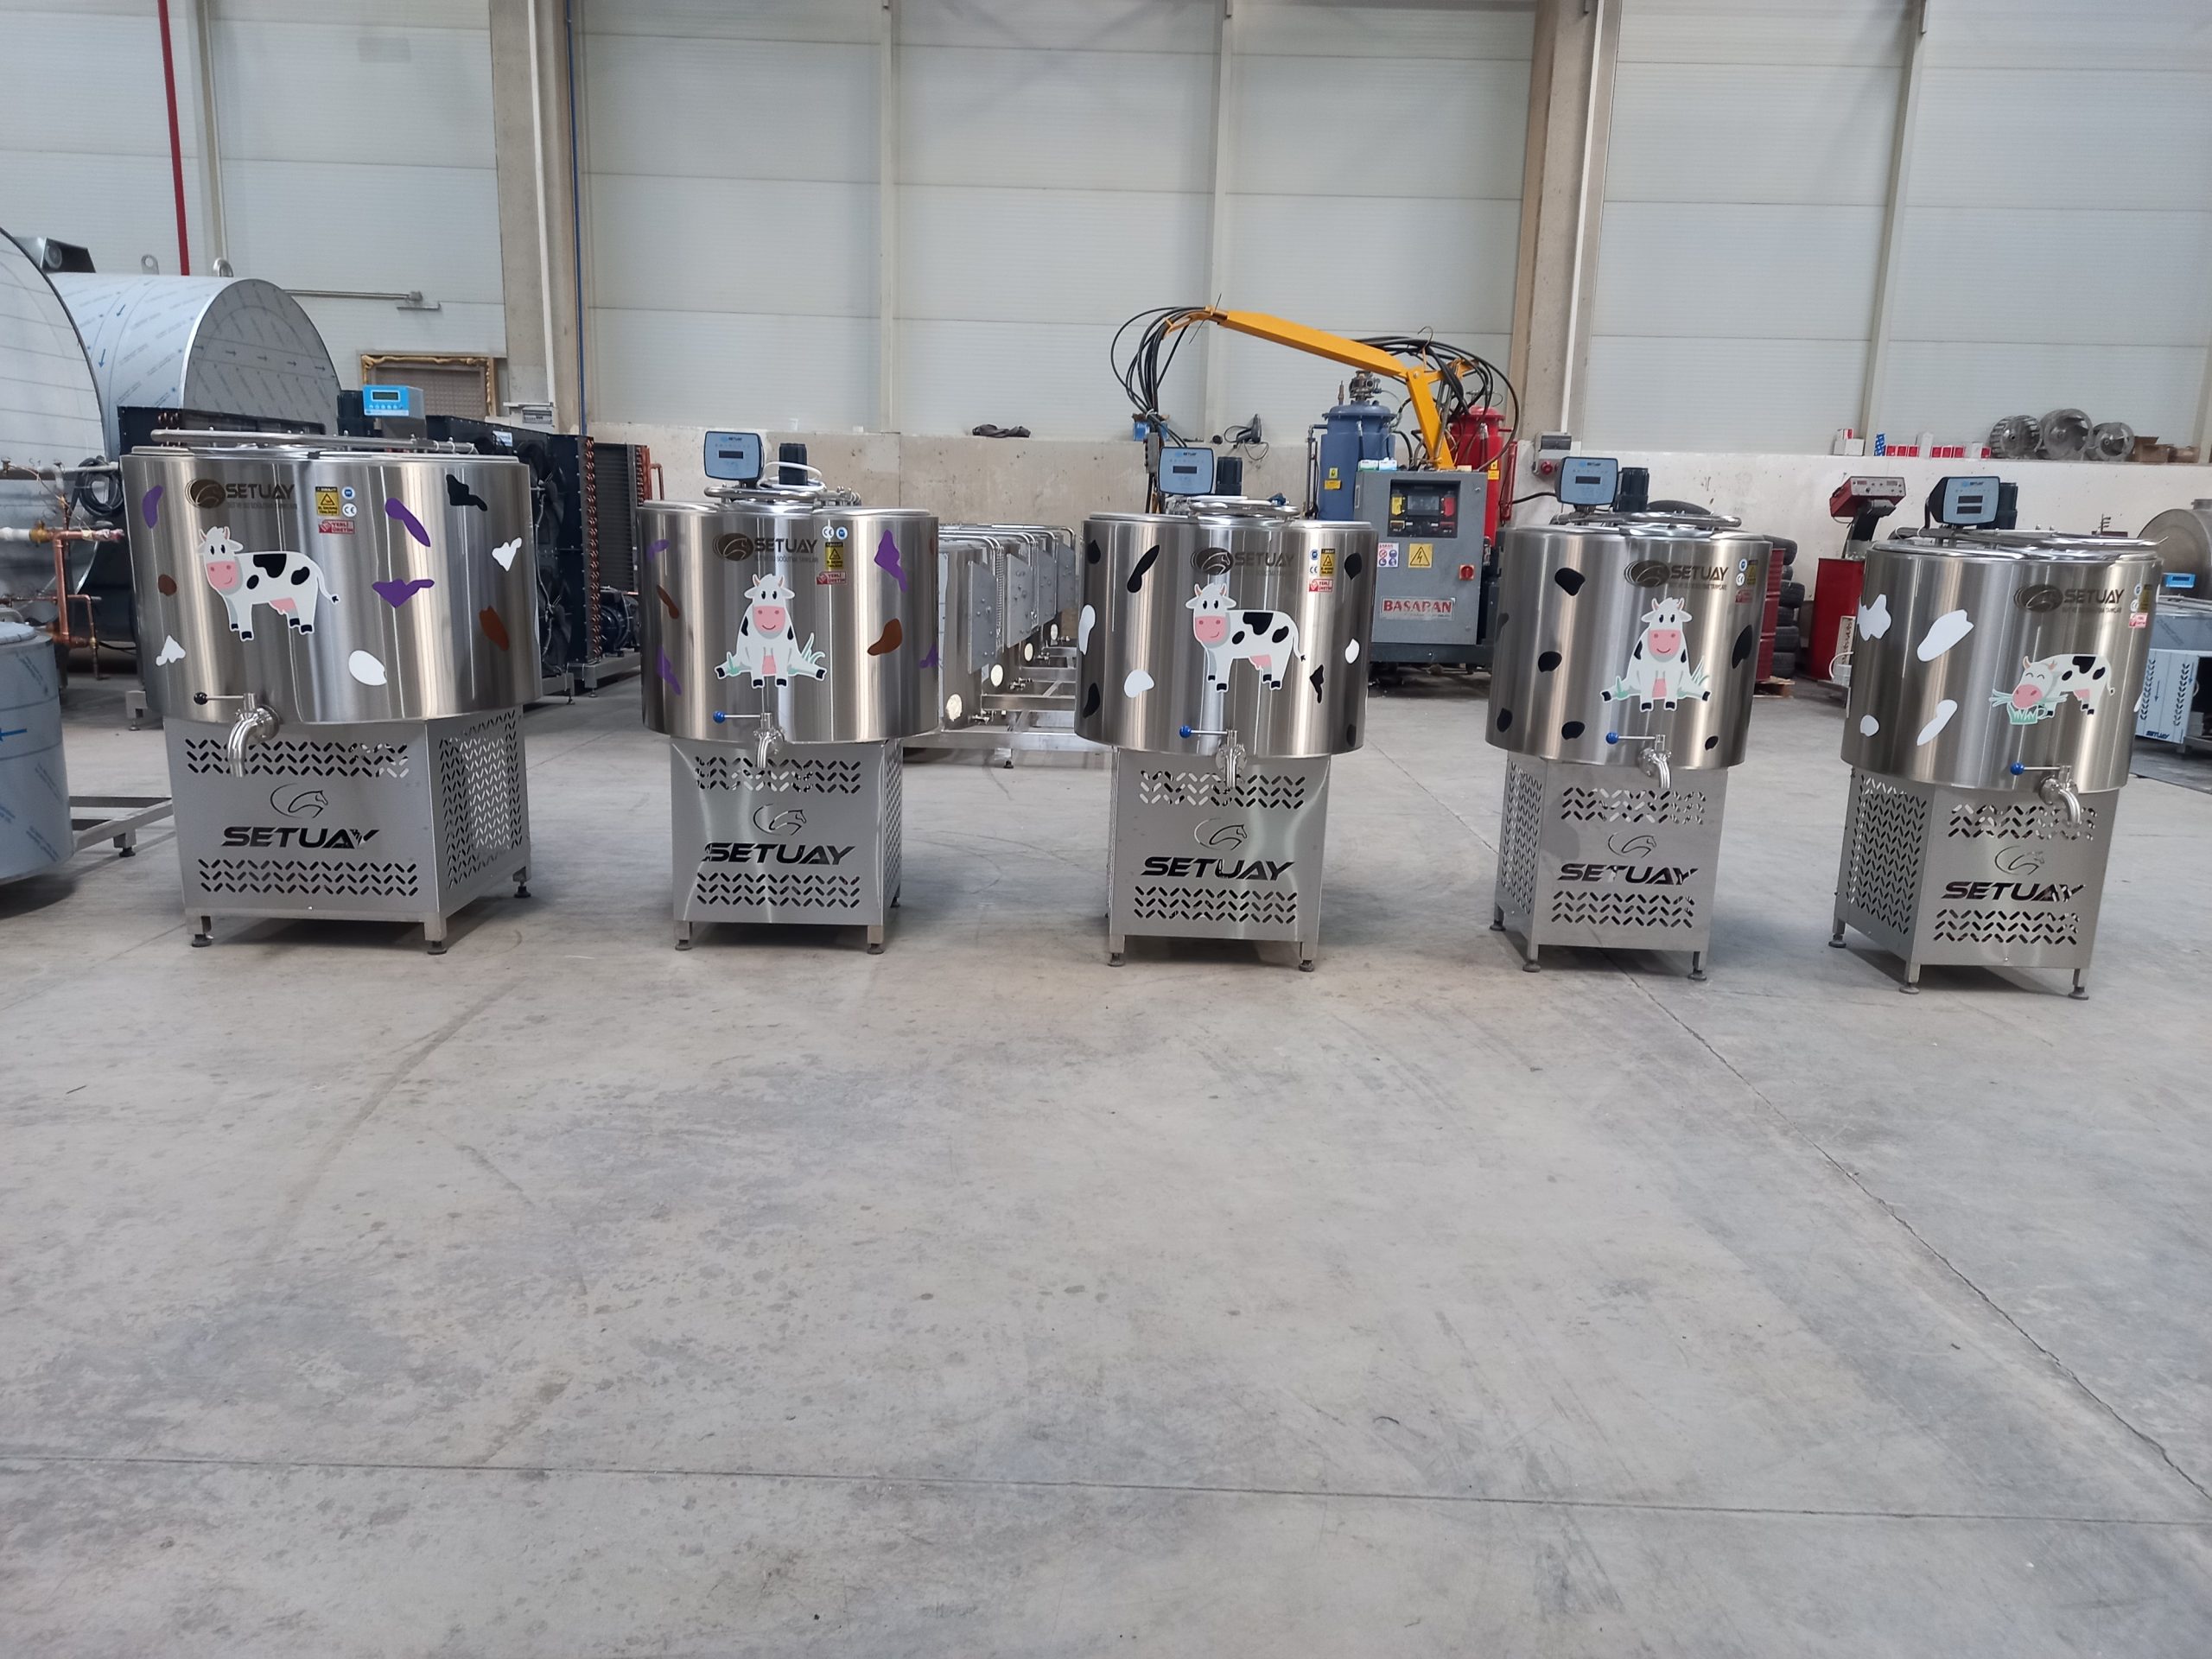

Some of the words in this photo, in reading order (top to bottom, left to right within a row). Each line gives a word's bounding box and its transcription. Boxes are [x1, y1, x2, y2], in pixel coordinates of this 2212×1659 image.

[226, 483, 296, 500] SETUAY
[754, 537, 819, 554] SETUAY
[1235, 551, 1294, 568] SETUAY
[1670, 565, 1729, 582] SETUAY
[2063, 588, 2126, 604] SETUAY
[220, 826, 380, 850] SETUAY
[701, 842, 856, 866] SETUAY
[1140, 856, 1295, 881] SETUAY
[1557, 862, 1699, 886] SETUAY
[1941, 880, 2086, 903] SETUAY
